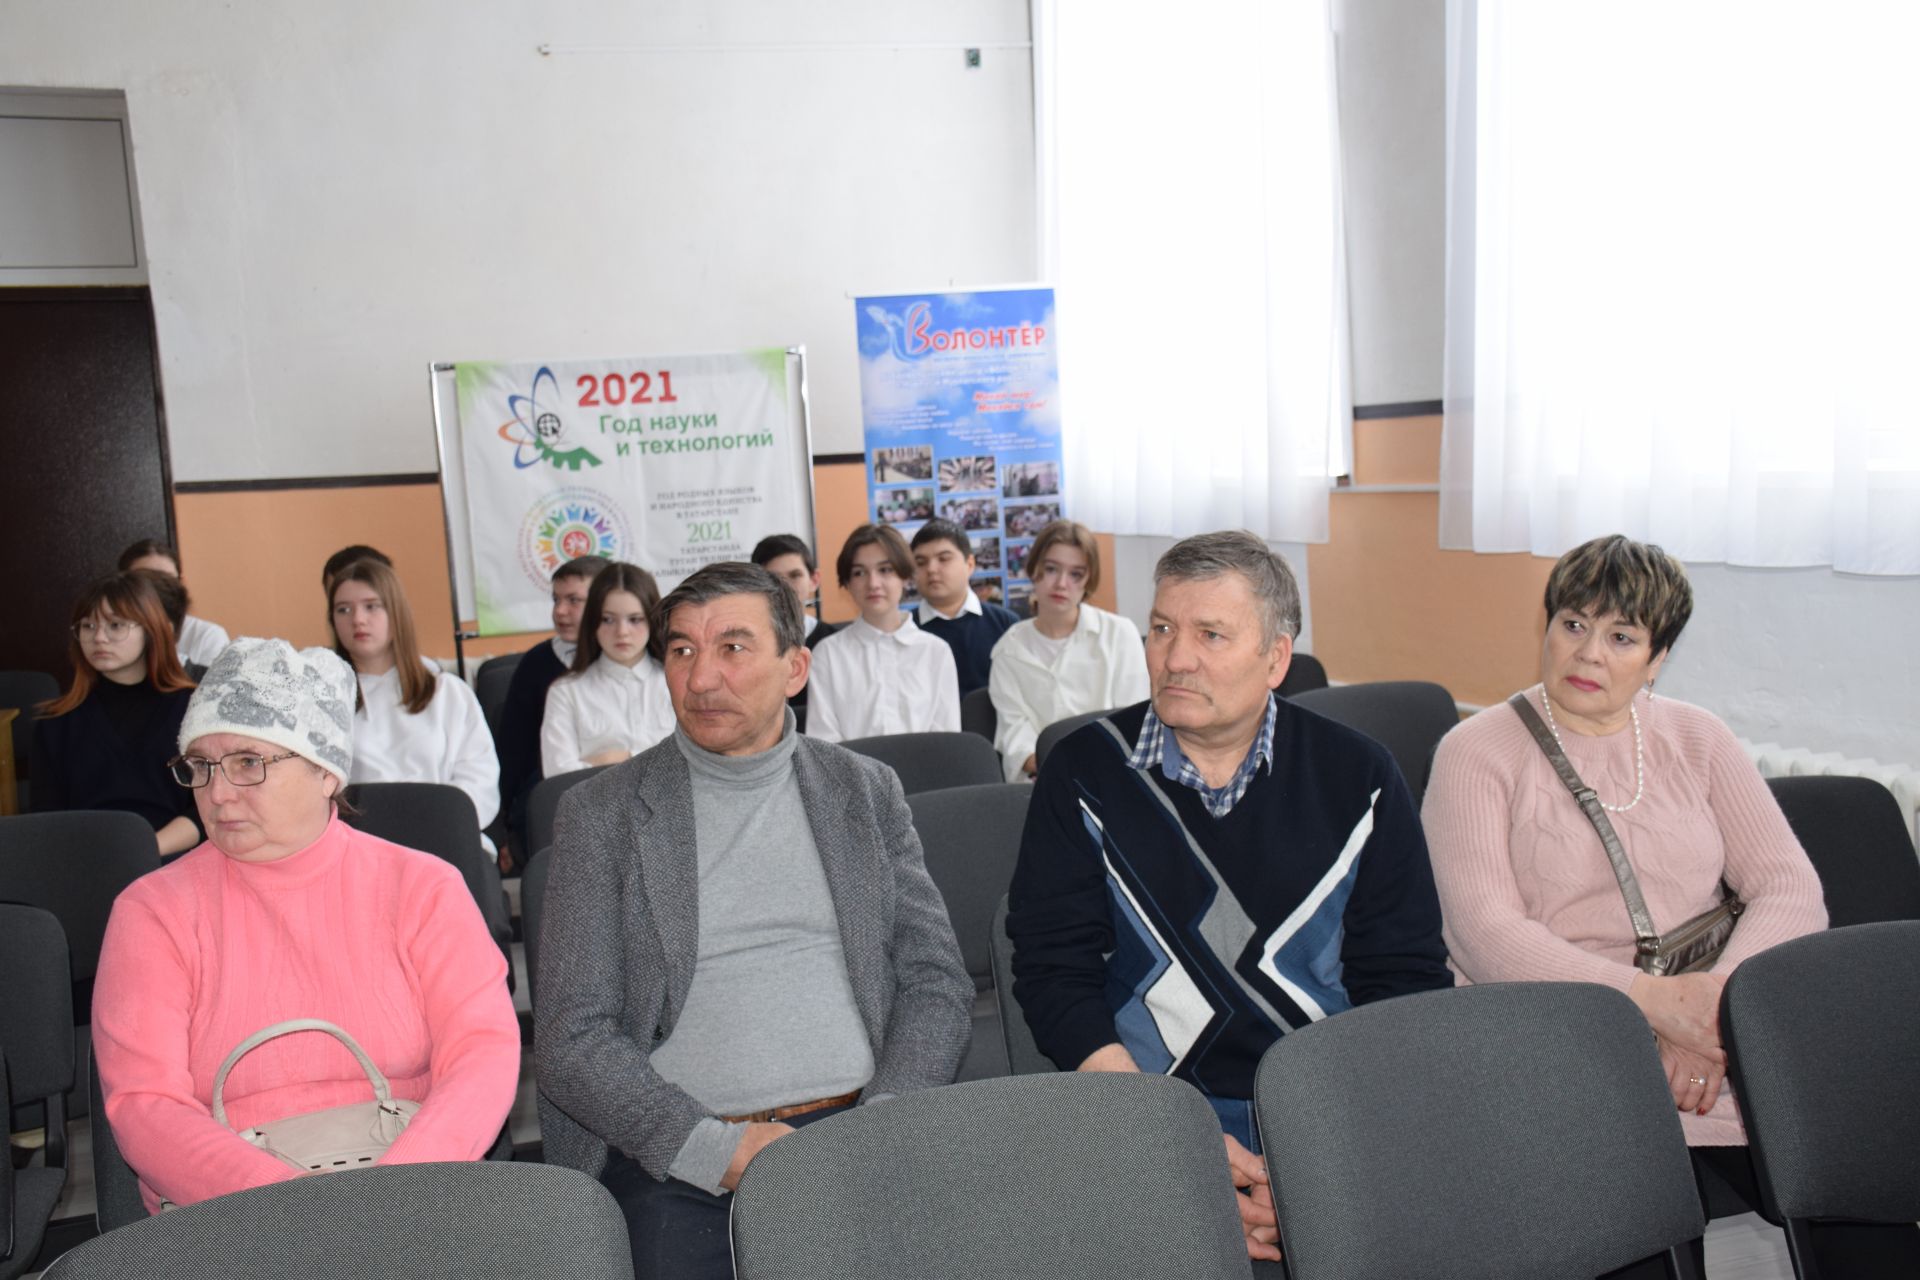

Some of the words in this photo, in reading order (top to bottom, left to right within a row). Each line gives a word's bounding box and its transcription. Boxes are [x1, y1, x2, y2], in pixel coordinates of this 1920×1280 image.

[577, 371, 678, 407] 2021
[600, 415, 643, 434] Год
[651, 413, 718, 434] науки
[616, 442, 630, 457] и
[639, 429, 774, 456] технологий
[687, 520, 732, 543] 2021
